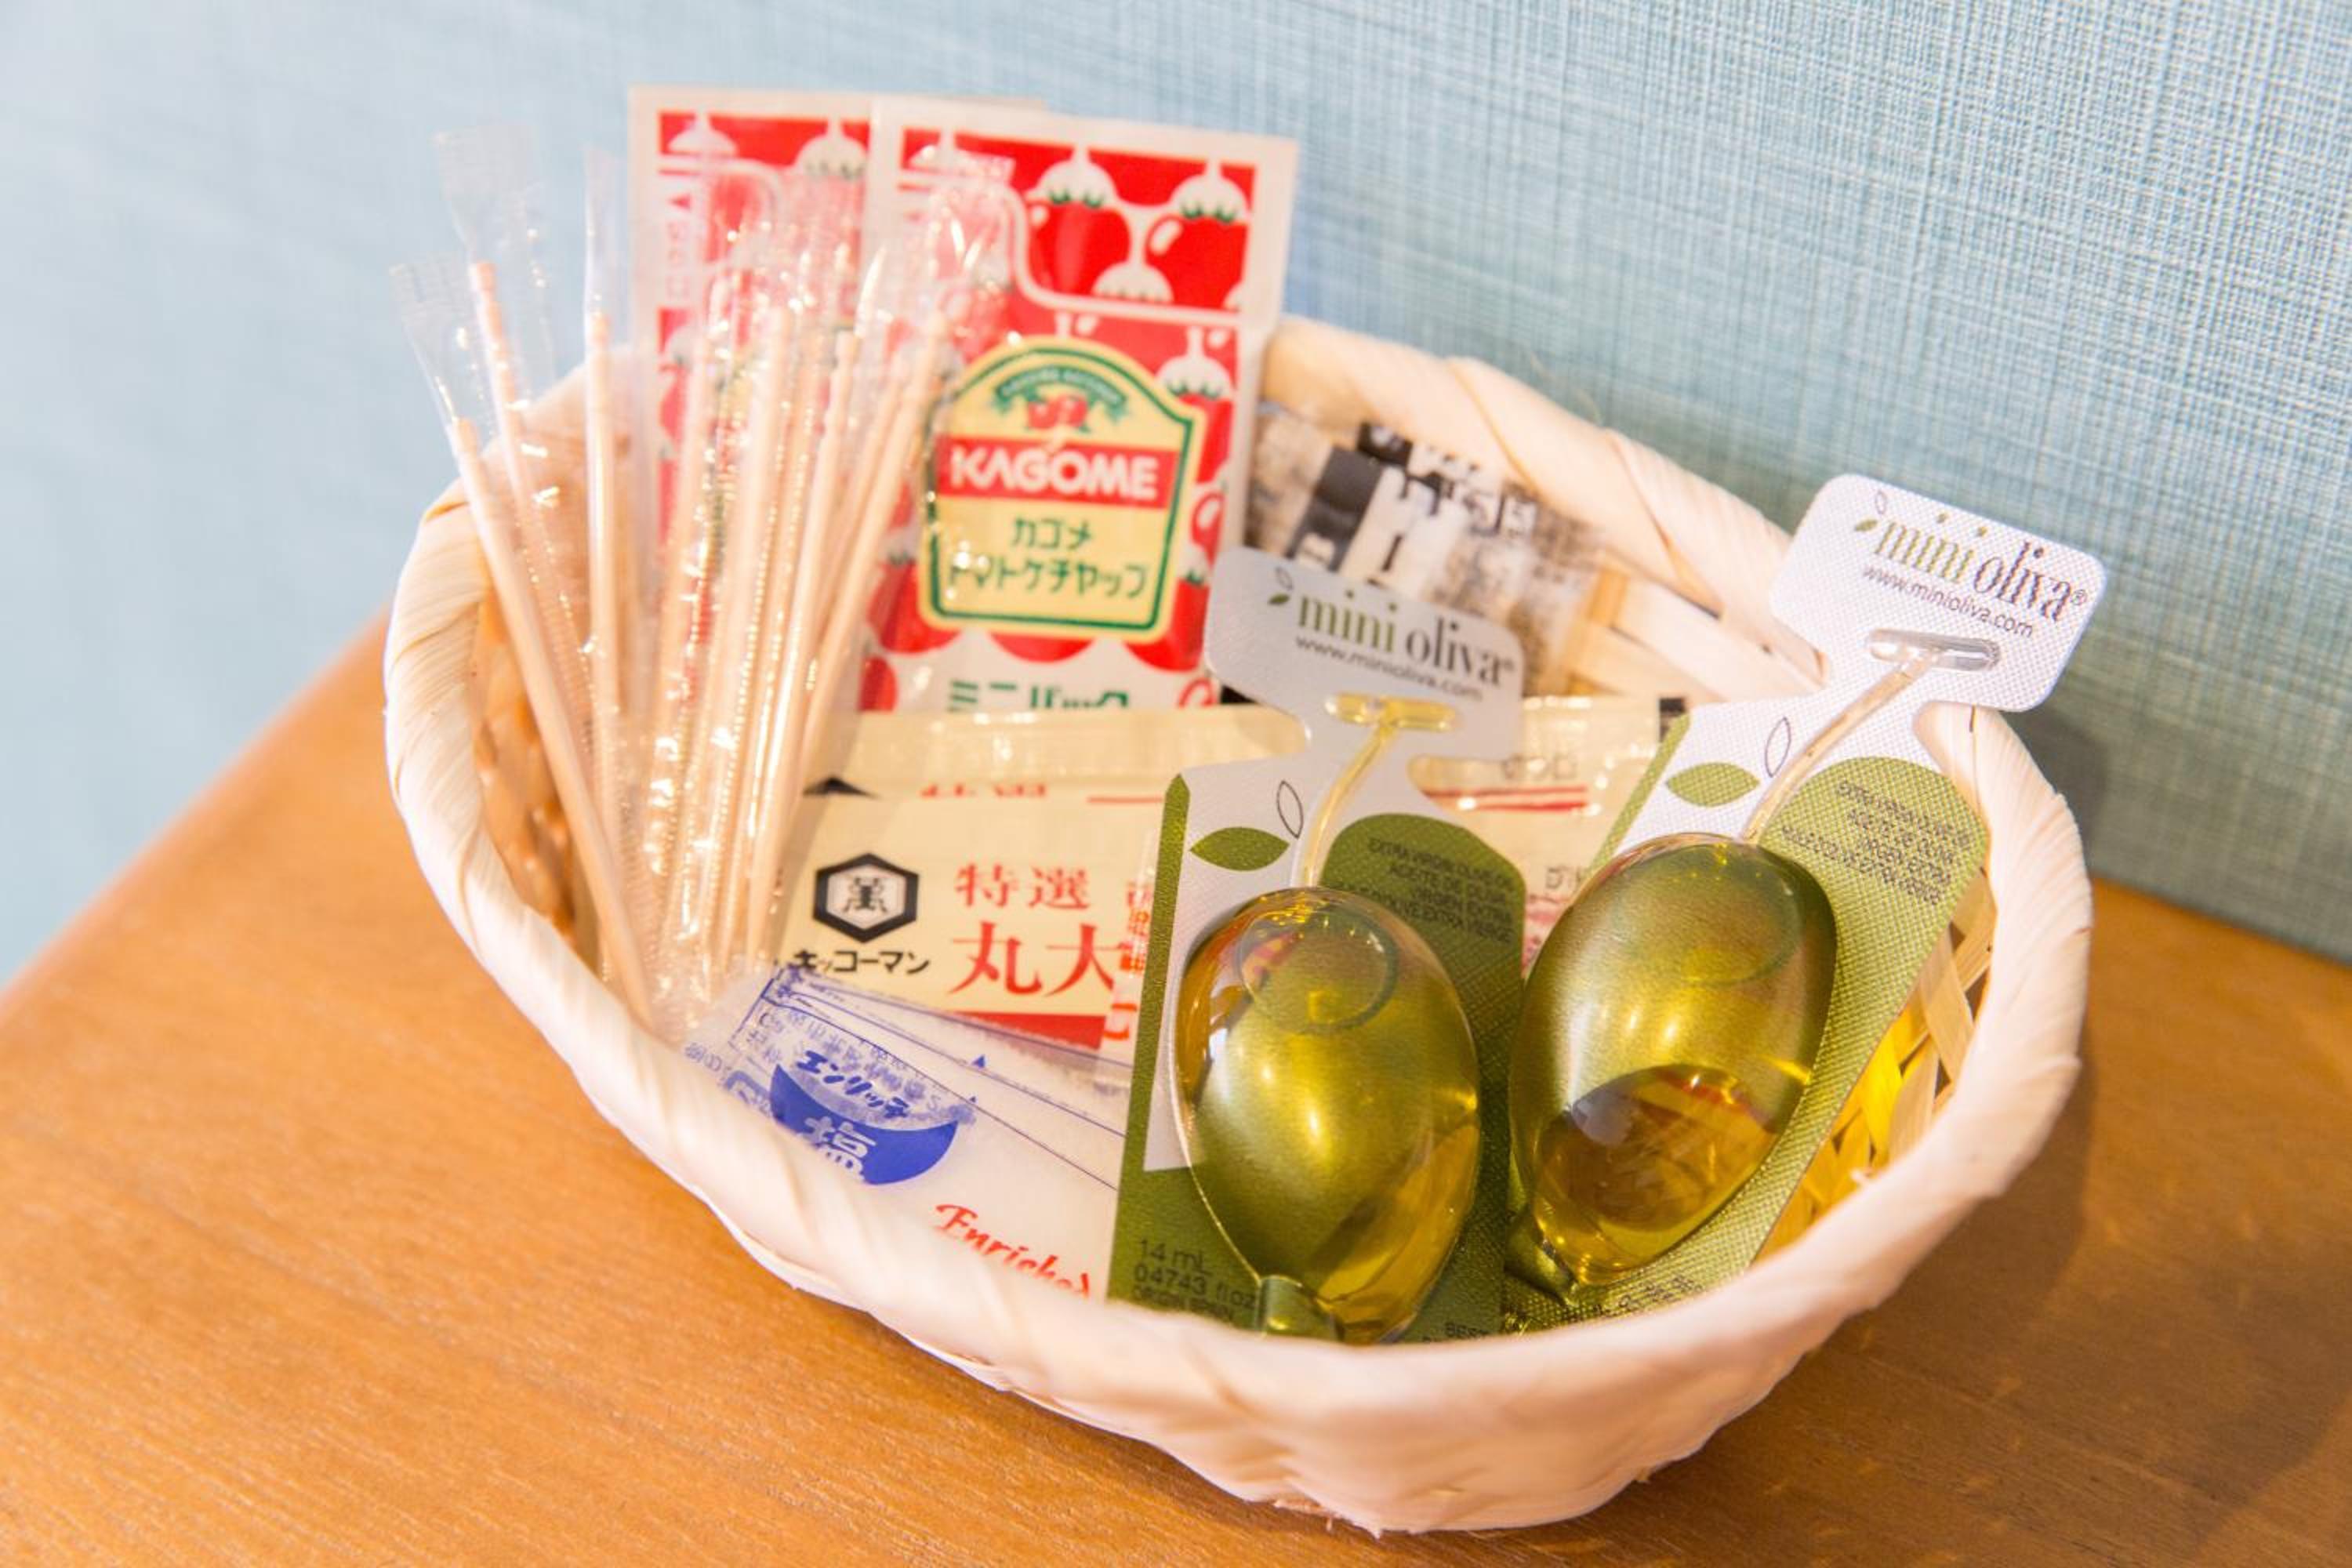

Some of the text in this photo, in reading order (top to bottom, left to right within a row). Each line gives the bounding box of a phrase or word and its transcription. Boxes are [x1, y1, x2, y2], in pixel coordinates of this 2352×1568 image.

[950, 446, 1159, 500] KAGOME
[1875, 512, 1973, 584] mini
[1298, 590, 1398, 653] mini
[1862, 564, 2034, 638] www.minioliva.com
[1296, 635, 1483, 702] www.minioliva.com
[954, 863, 1091, 910] 特選
[1139, 1239, 1166, 1261] 14
